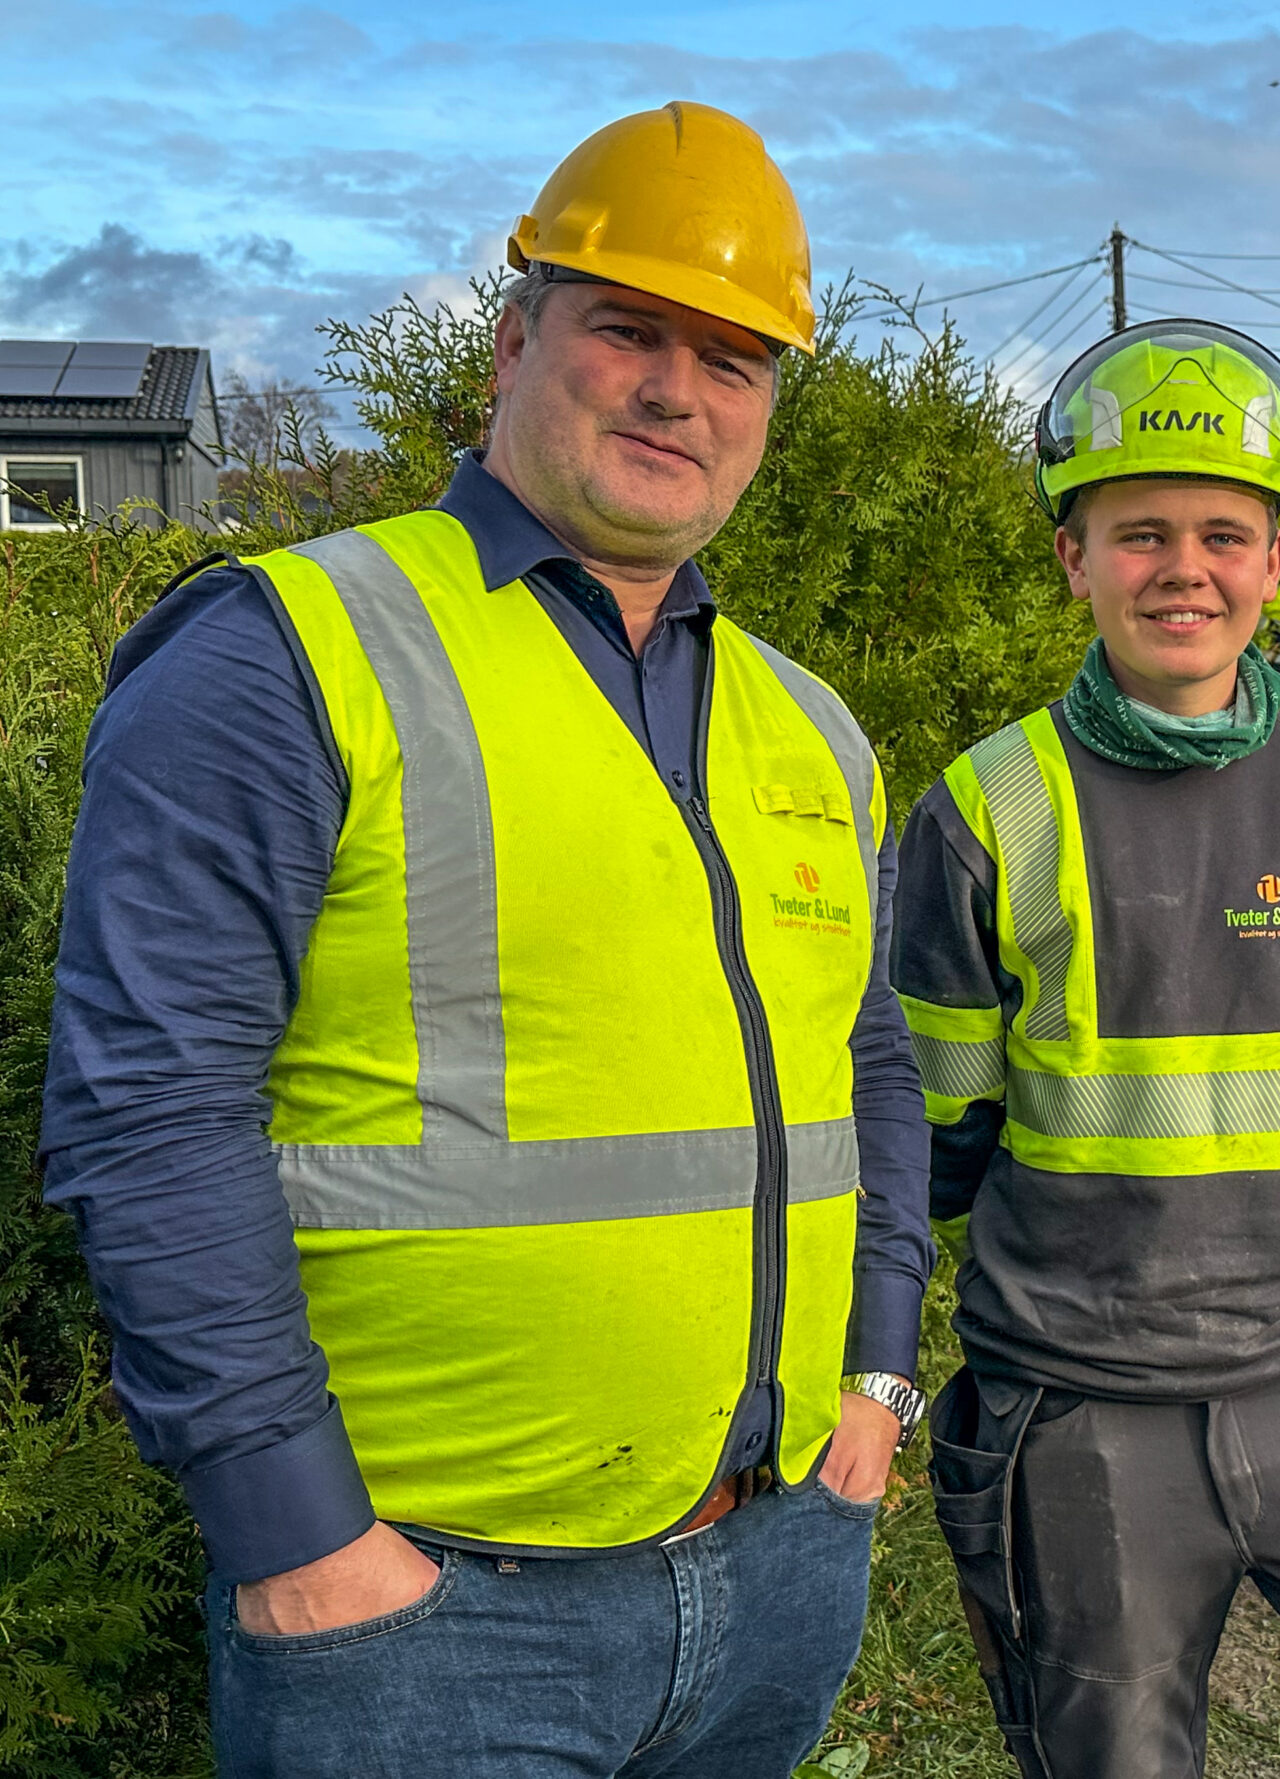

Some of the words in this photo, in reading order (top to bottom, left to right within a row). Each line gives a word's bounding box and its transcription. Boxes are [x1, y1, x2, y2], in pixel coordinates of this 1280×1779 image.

[1139, 410, 1225, 436] KASK
[769, 893, 812, 917] Tveter
[814, 898, 825, 919] &
[825, 899, 851, 924] Lund
[1223, 908, 1270, 927] Tveter
